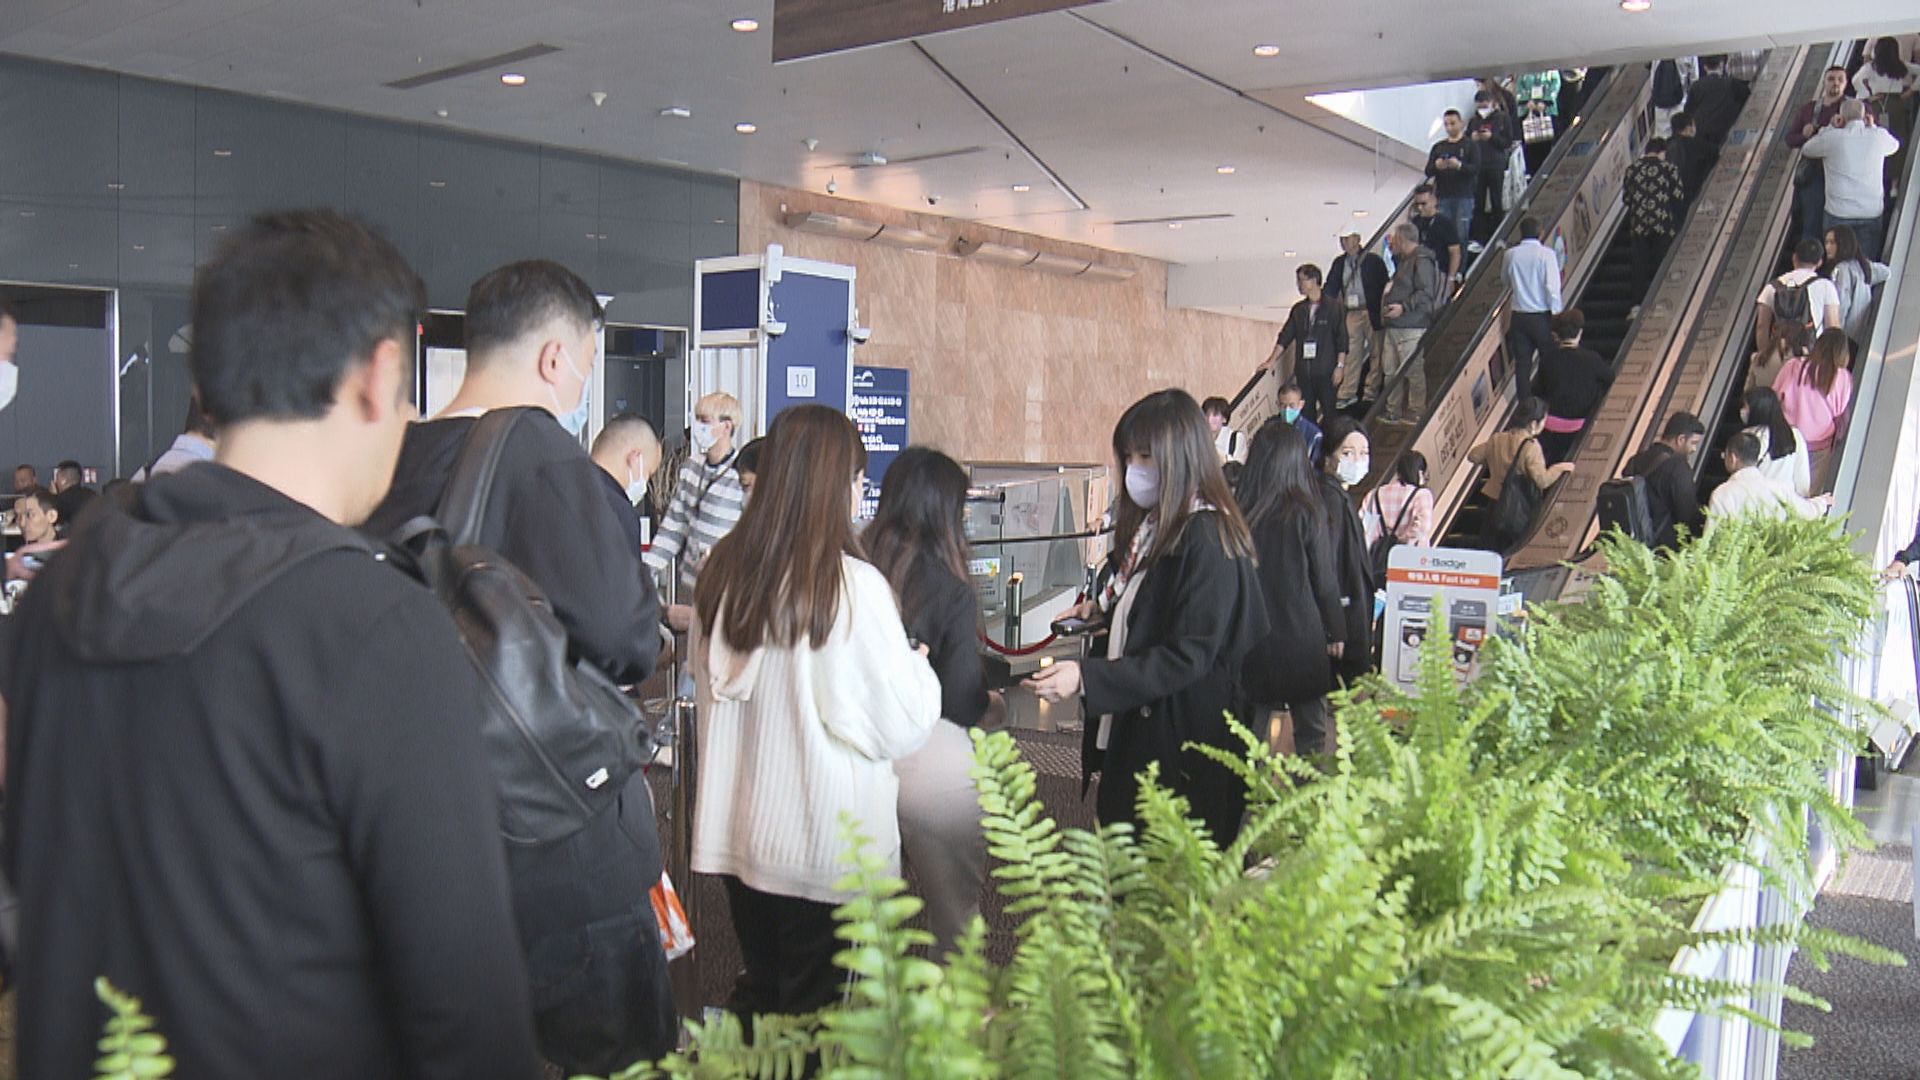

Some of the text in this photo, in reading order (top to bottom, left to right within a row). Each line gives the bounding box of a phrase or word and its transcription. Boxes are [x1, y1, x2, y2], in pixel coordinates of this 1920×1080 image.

[795, 374, 808, 388] 10
[1420, 557, 1467, 569] e-Badge
[1441, 573, 1480, 585] Fast Lane
